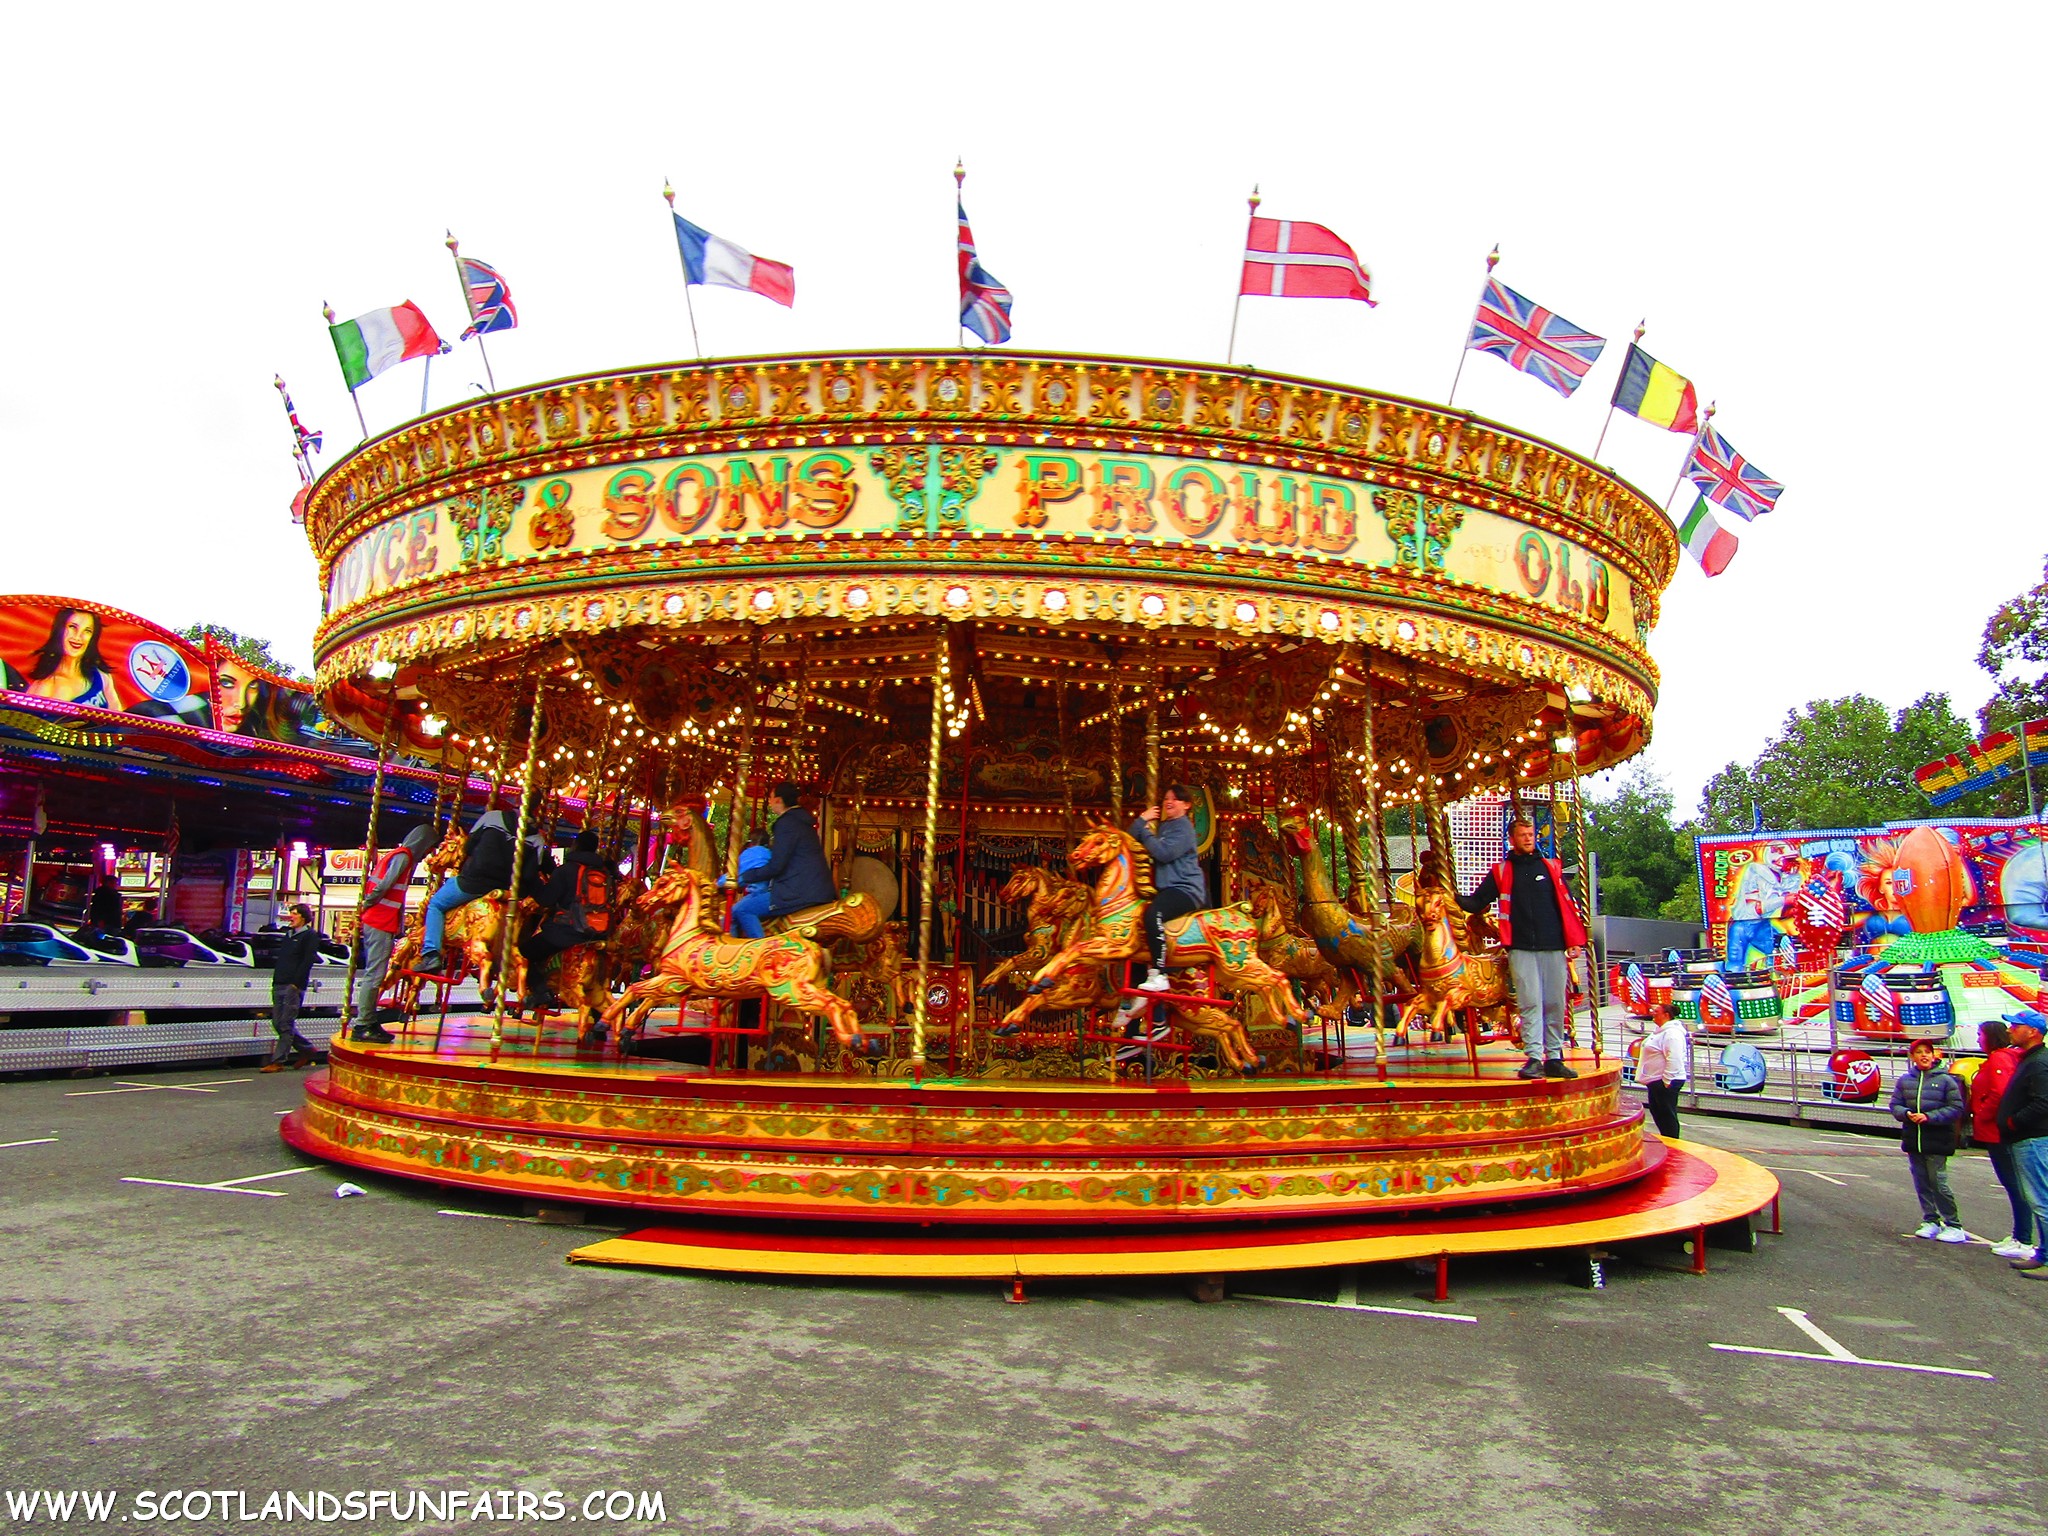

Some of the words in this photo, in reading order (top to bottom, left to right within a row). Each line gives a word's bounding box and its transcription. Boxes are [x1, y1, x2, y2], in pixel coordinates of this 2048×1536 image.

[528, 478, 576, 551] &
[601, 452, 859, 541] SONS
[1013, 454, 1360, 555] PROUD
[1513, 530, 1610, 624] OLD
[1895, 880, 1909, 892] NFL
